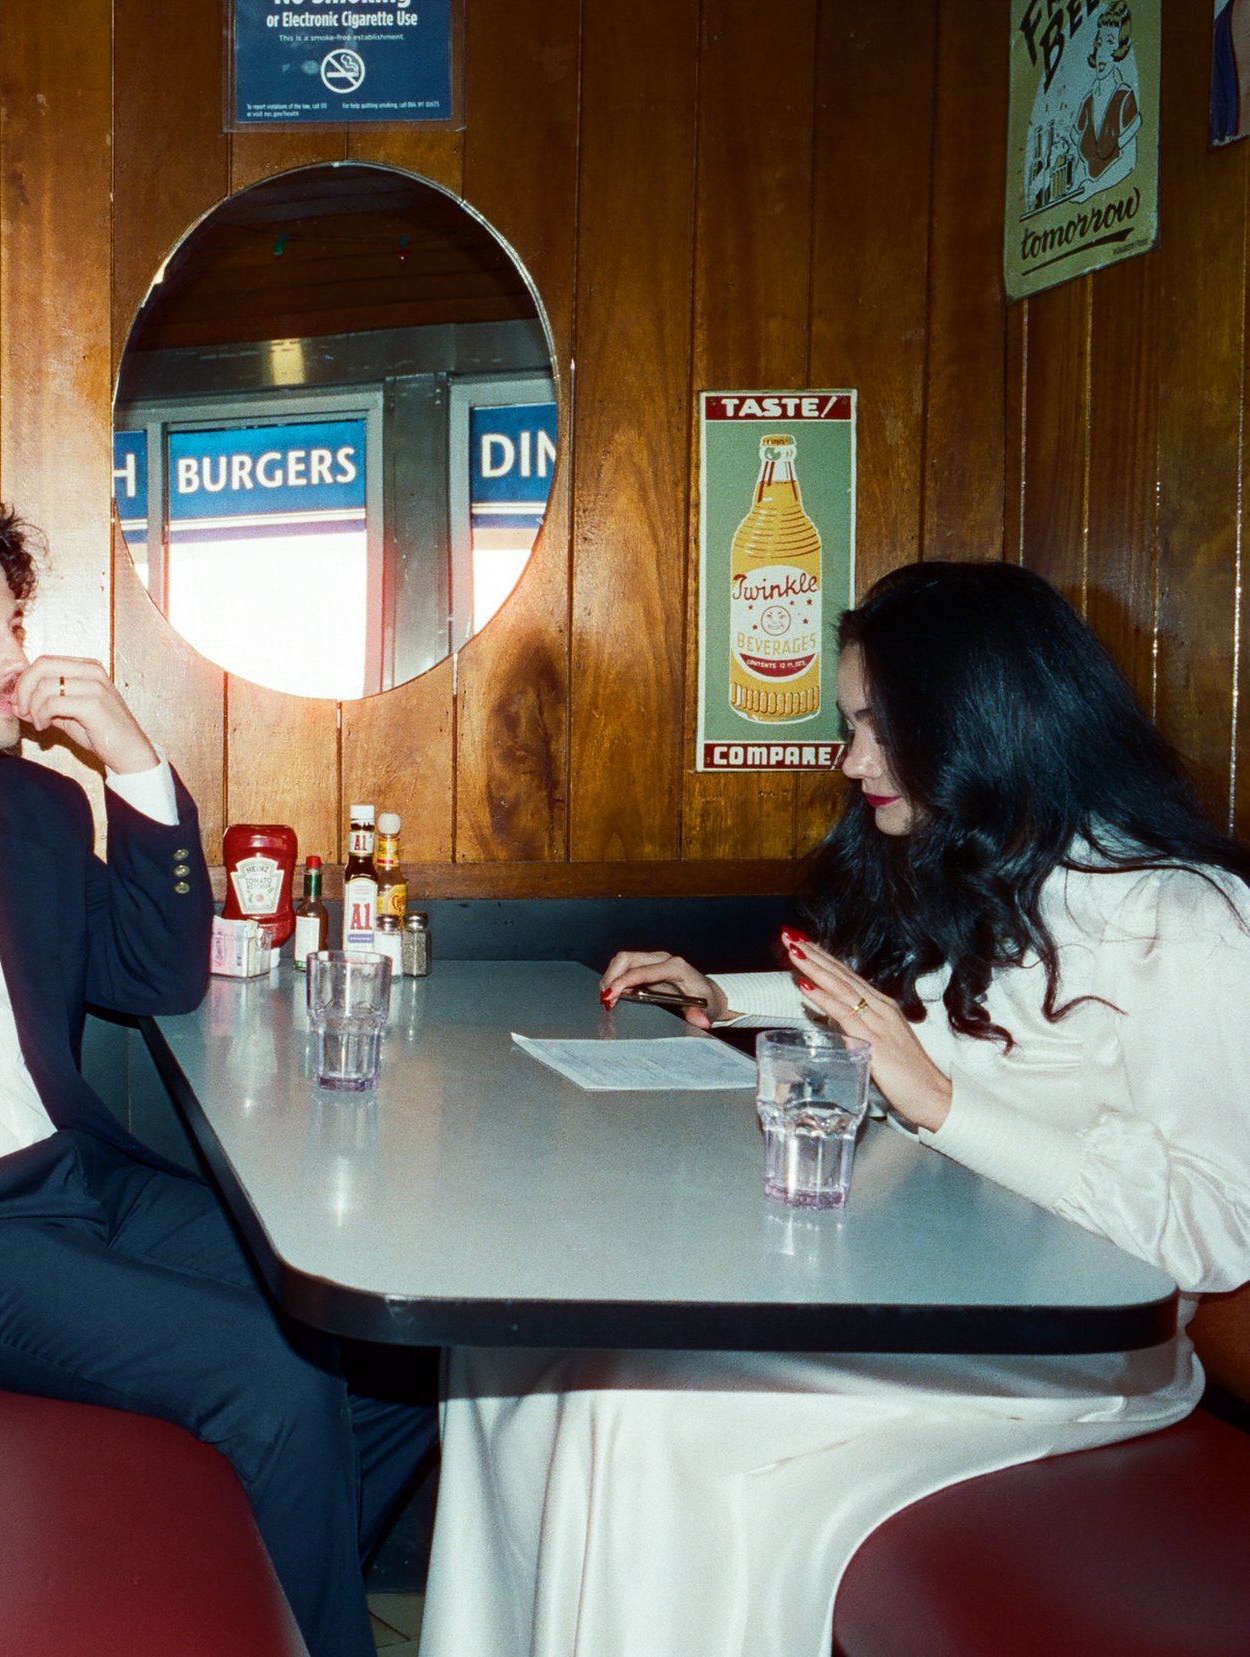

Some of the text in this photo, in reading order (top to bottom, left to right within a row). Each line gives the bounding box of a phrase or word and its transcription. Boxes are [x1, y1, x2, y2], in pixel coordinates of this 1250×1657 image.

[266, 11, 418, 29] or Electronic Cigarette Use
[311, 33, 351, 41] smoke-free
[1021, 187, 1141, 261] tomorrow
[721, 395, 838, 419] TASTE!
[177, 447, 357, 494] BURGERS
[732, 572, 818, 602] Twinkle
[737, 631, 817, 655] BEVERAGES
[746, 659, 777, 669] CONTENTS
[713, 744, 845, 771] COMPARE!
